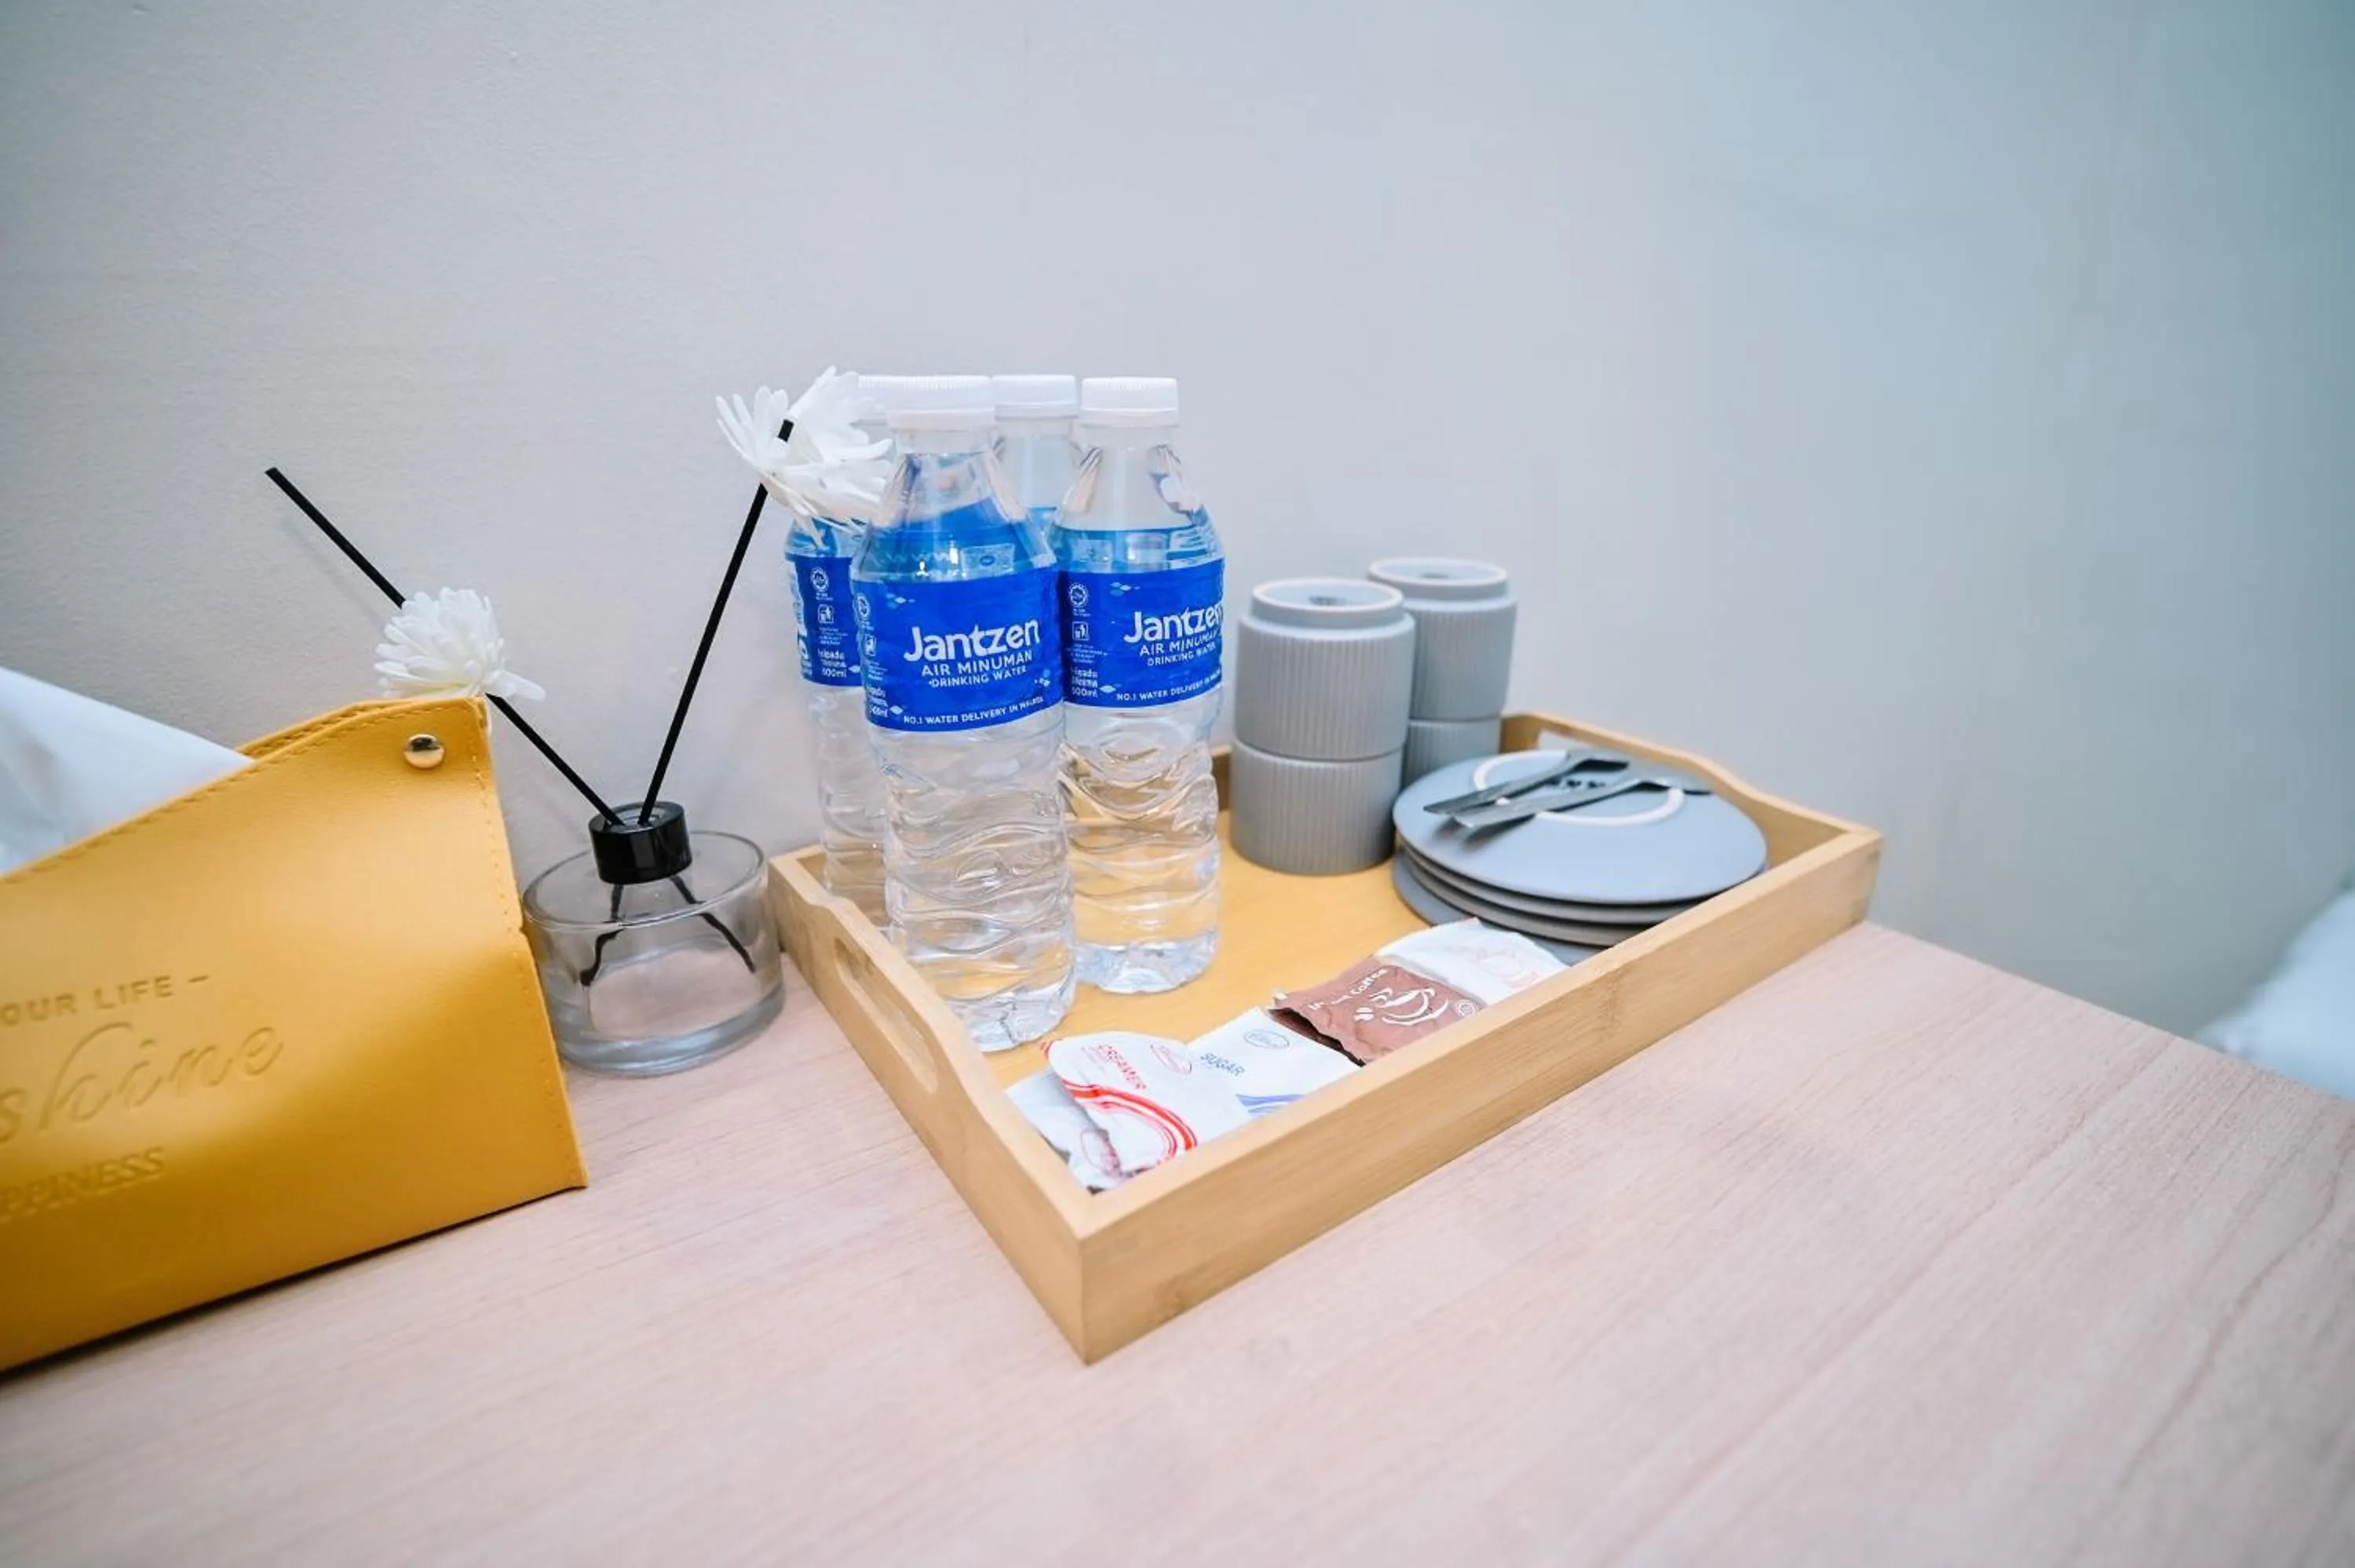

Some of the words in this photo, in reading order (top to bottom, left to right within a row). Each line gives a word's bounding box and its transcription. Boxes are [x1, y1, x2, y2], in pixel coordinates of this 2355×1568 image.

[1123, 603, 1223, 643] Jantzen
[904, 619, 1040, 662] Jantzen
[1140, 643, 1164, 657] AIR
[922, 663, 951, 676] AIR
[957, 649, 1032, 675] MINUMAN
[1147, 651, 1194, 666] DRINKING
[931, 673, 990, 687] DRINKING
[993, 665, 1028, 680] WATER
[1139, 690, 1169, 701] WATER
[904, 715, 922, 724] NO.1
[925, 715, 958, 724] WATER
[961, 707, 1007, 722] DELIVERY
[93, 975, 176, 1010] LIFE
[1200, 1052, 1246, 1078] SUGAR
